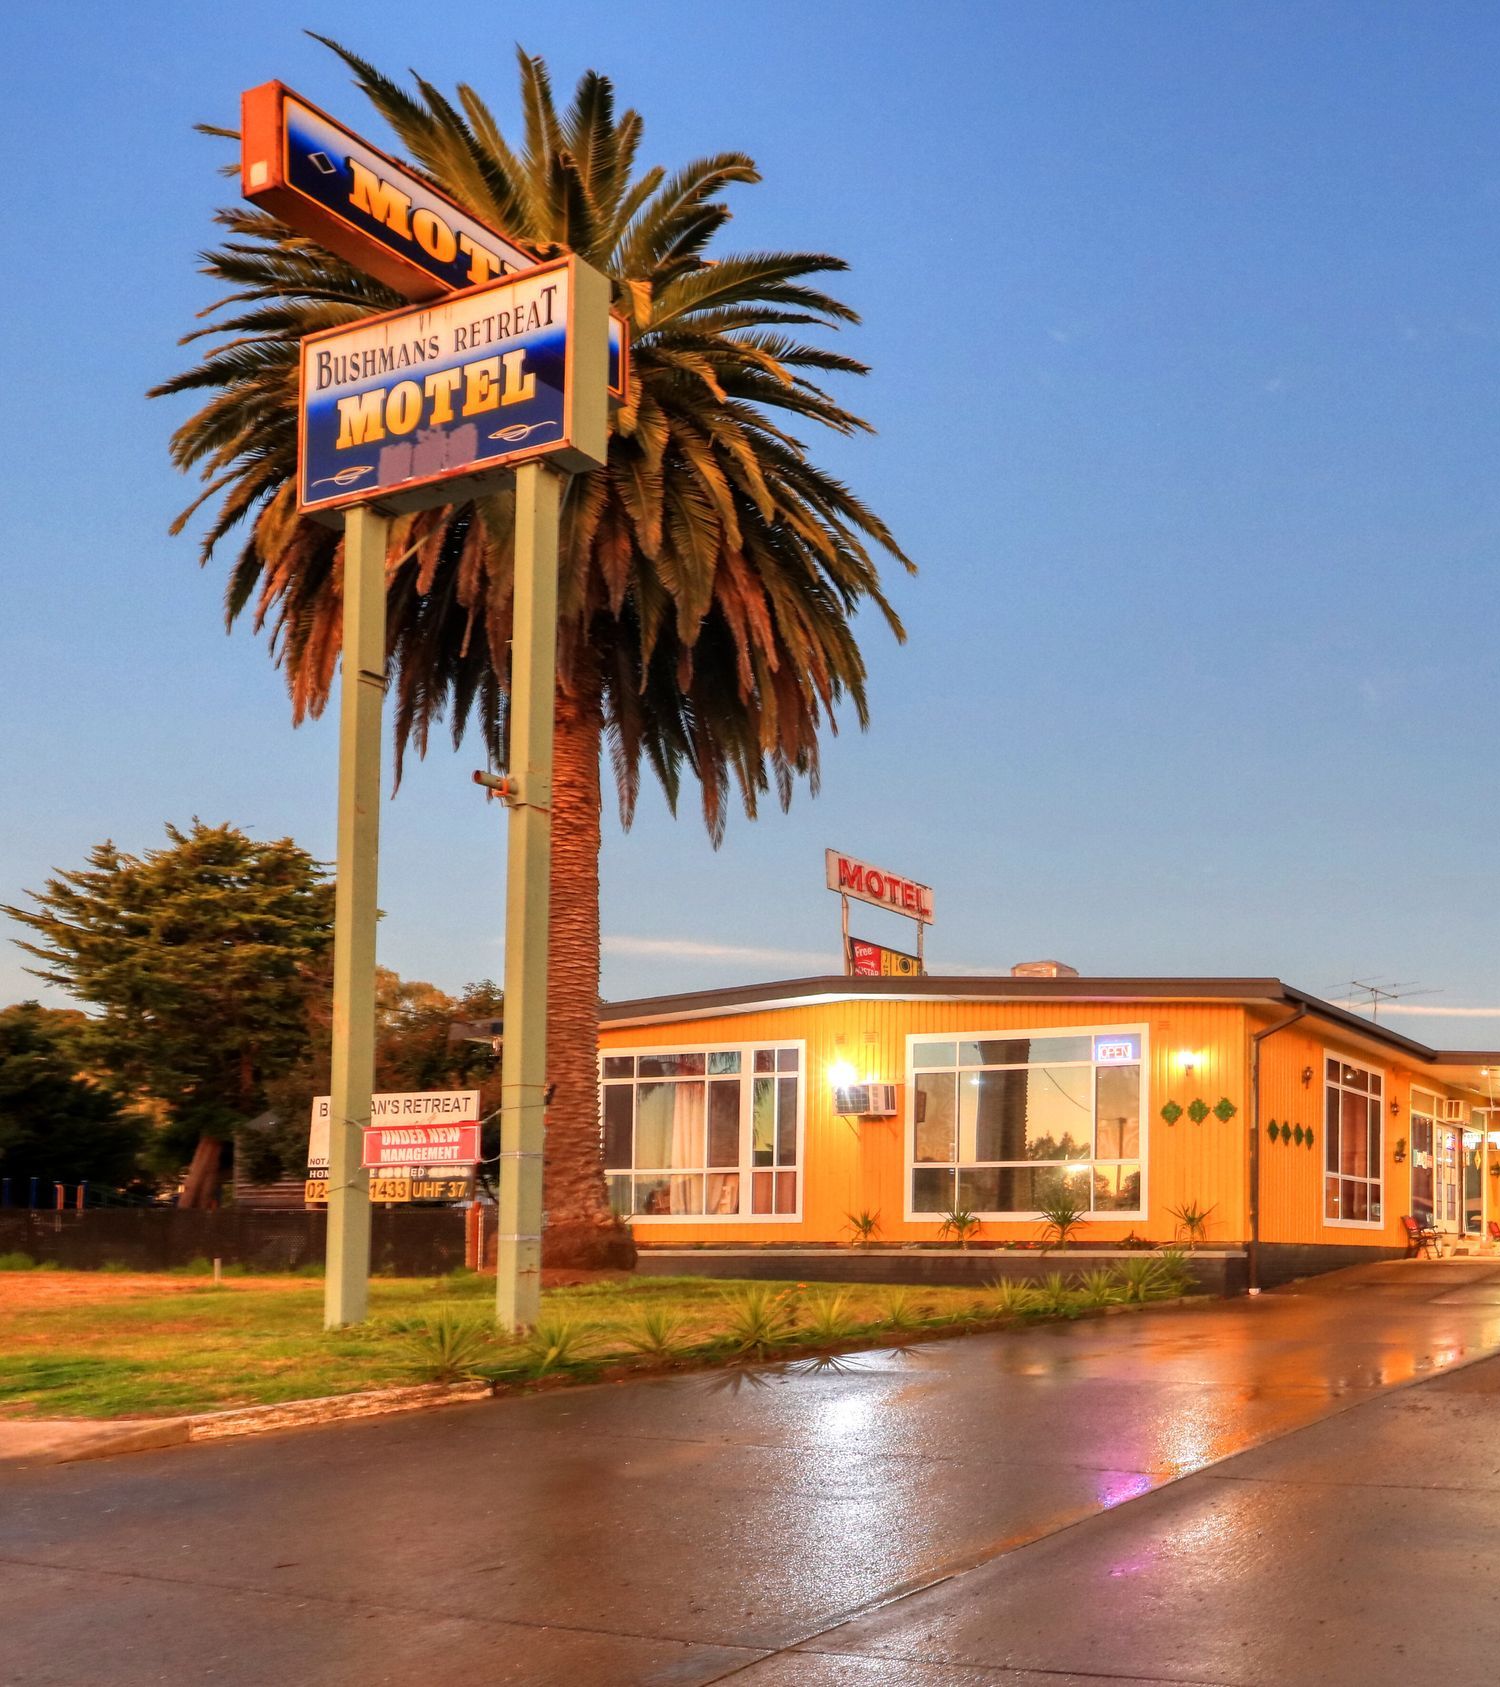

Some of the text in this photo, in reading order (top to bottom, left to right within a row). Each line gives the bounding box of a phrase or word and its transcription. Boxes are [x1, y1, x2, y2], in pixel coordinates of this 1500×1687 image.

[346, 156, 520, 284] MOT
[316, 285, 558, 391] BUSHMANS RETREAT
[335, 348, 536, 450] MOTEL
[838, 858, 931, 917] MOTEL
[854, 946, 873, 958] Free
[1101, 1045, 1129, 1058] OPEN
[403, 1097, 471, 1114] RETREAT
[381, 1127, 460, 1146] UNDER NEW
[310, 1158, 325, 1166] NOT
[380, 1146, 460, 1162] MANAGEMENT
[370, 1181, 406, 1198] 1433
[412, 1181, 446, 1198] UHF
[447, 1181, 467, 1198] 37
